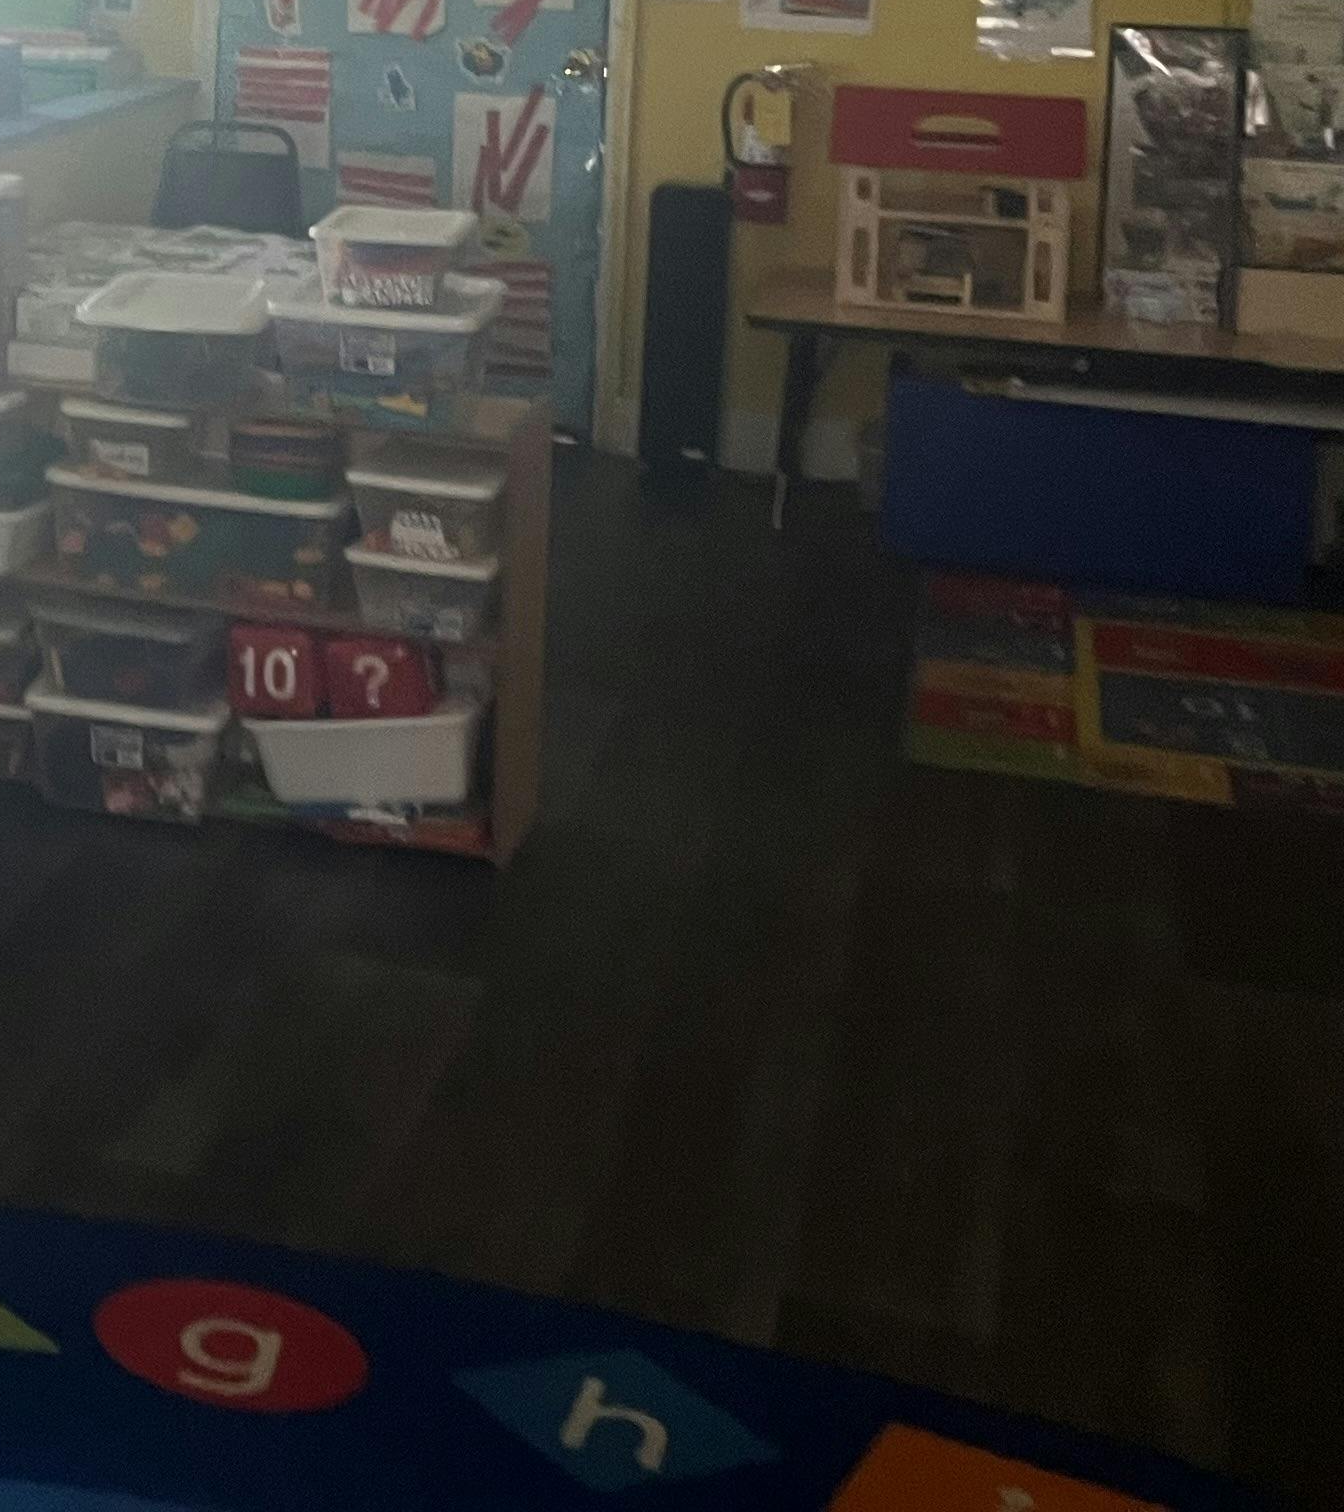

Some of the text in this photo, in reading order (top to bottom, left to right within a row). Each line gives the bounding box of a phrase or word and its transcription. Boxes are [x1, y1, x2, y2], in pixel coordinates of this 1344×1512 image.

[240, 645, 297, 701] 10
[176, 1316, 283, 1396] g
[558, 1375, 665, 1473] h
